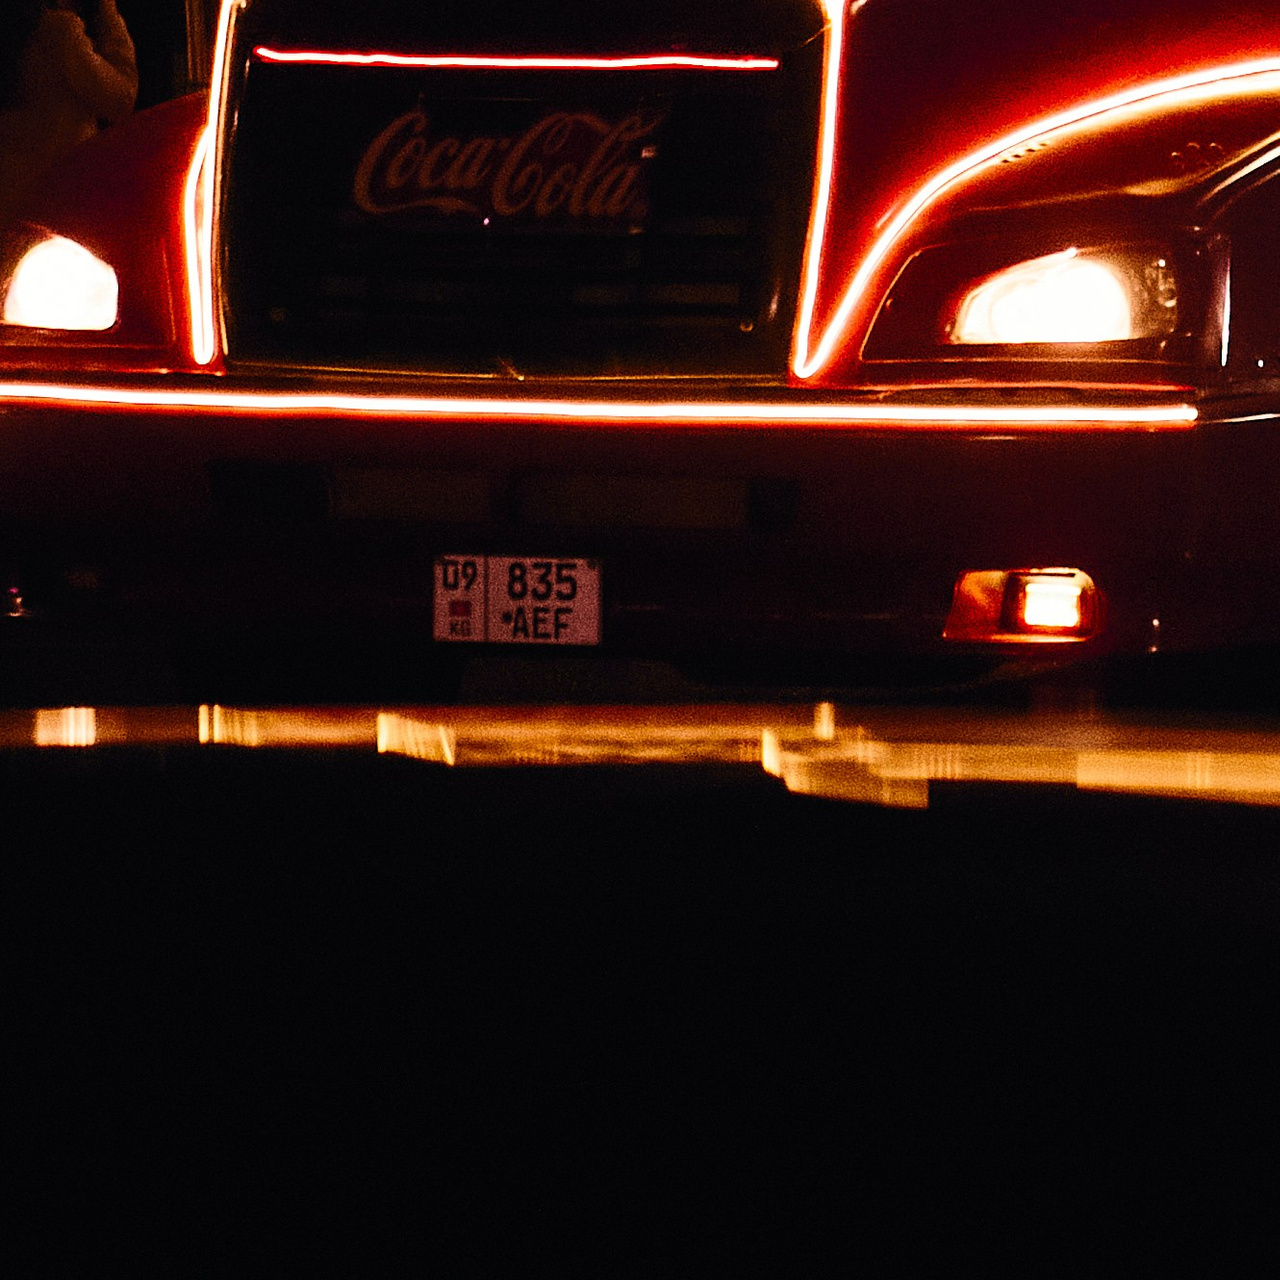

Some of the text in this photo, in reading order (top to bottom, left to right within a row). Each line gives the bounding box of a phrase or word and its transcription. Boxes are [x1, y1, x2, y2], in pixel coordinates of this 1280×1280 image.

[443, 560, 577, 601] 09 835
[512, 606, 574, 640] AEF
